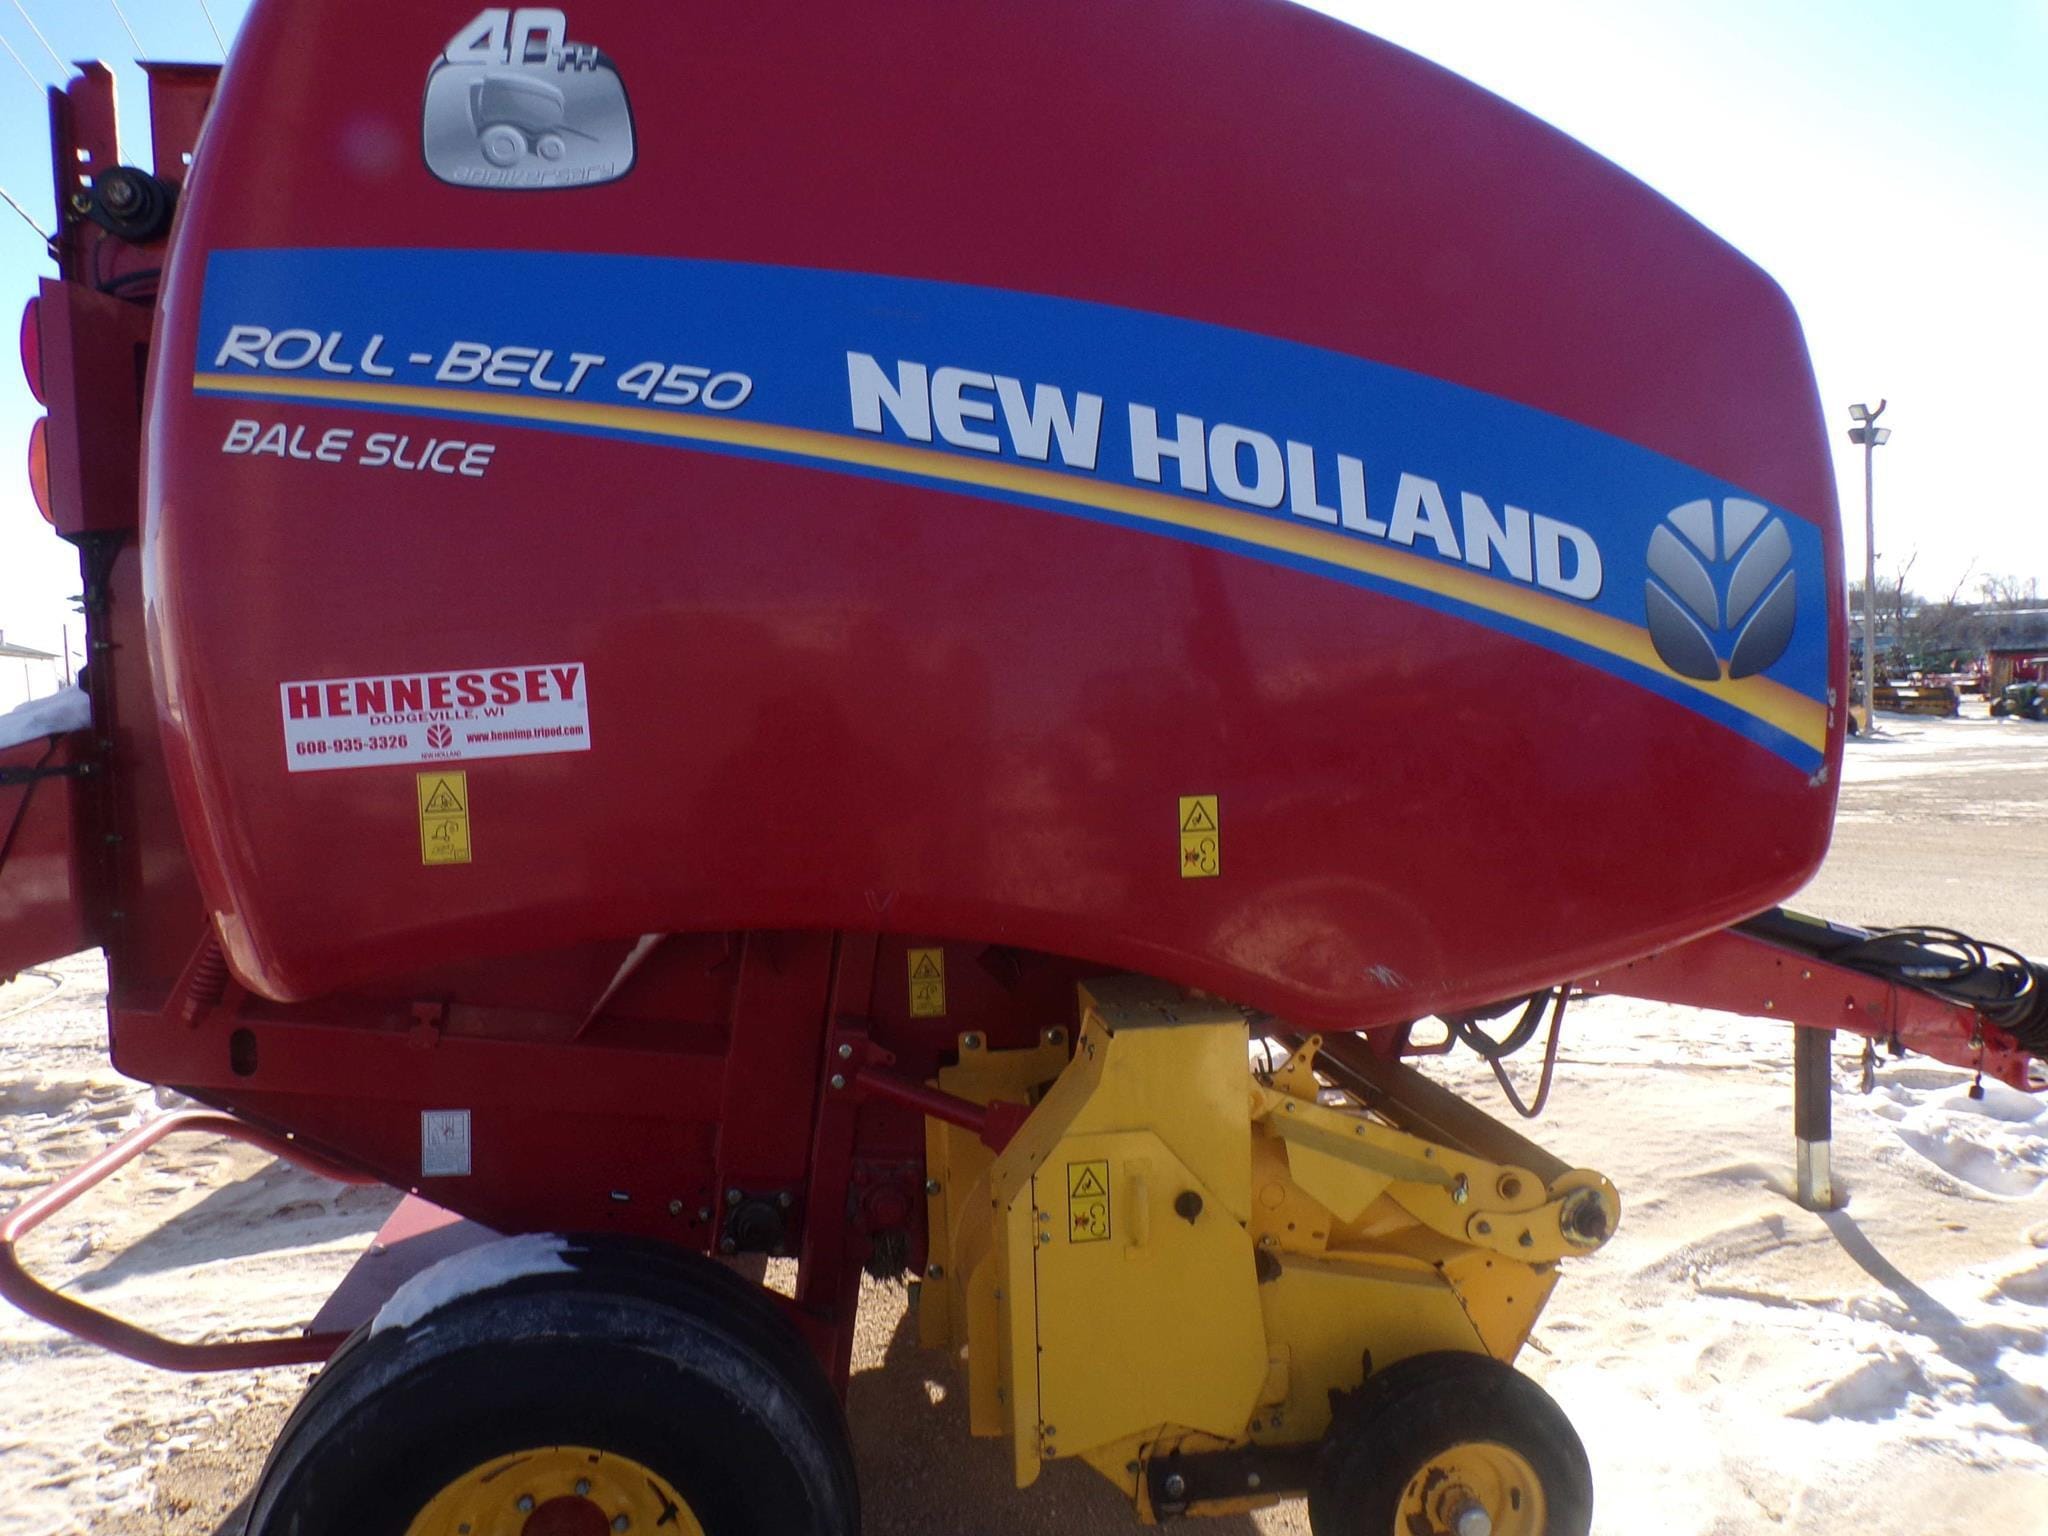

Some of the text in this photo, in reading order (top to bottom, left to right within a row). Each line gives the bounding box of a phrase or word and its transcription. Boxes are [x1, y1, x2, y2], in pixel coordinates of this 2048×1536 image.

[616, 361, 753, 412] 450
[222, 419, 495, 478] BALE SLICE
[846, 350, 1603, 601] NEW HOLLAND
[287, 667, 580, 720] HENNESSEY
[369, 706, 505, 727] DODGEVILLE, WI
[296, 724, 584, 756] 608-935-3326 www.hennimp.tripod.com
